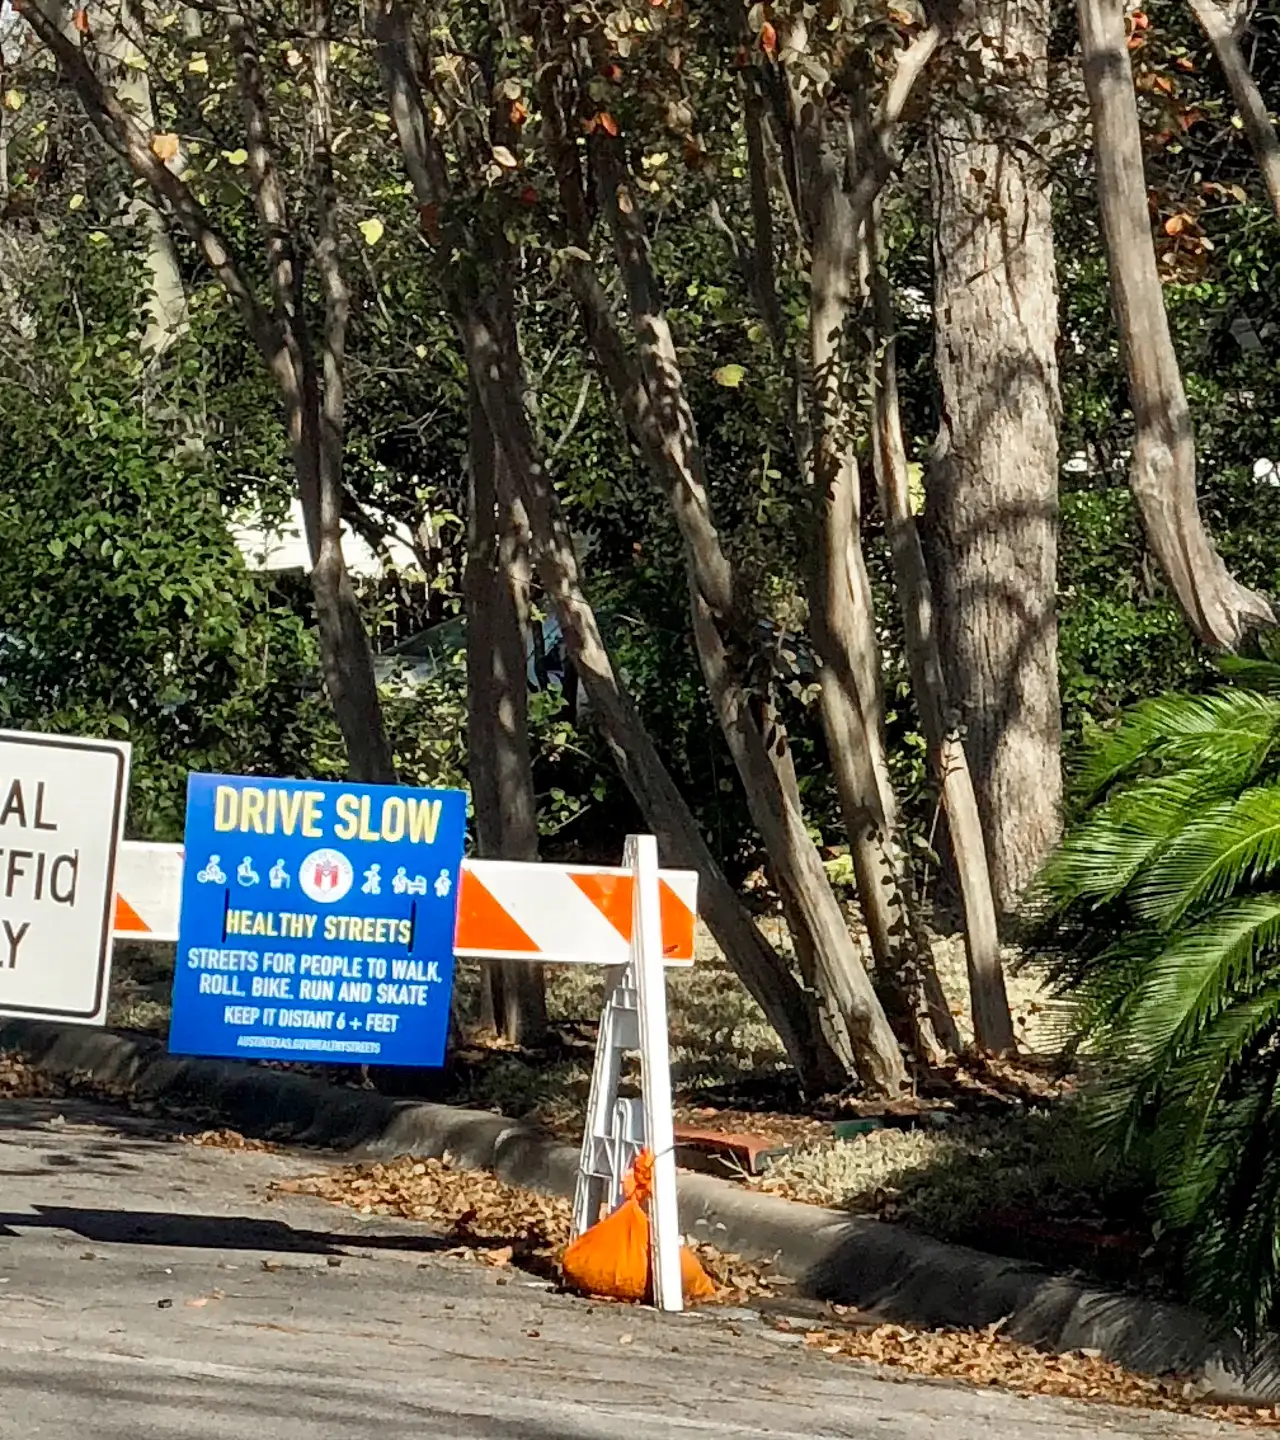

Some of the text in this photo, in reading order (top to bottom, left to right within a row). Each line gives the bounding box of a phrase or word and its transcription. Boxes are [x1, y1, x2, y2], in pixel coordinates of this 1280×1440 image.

[214, 785, 442, 844] DRIVE SLOW
[226, 909, 412, 945] HEALTHY STREETS
[188, 947, 259, 972] STREETS
[263, 952, 295, 975] FOR
[300, 954, 362, 978] PEOPLE
[367, 957, 387, 980] TO
[299, 979, 334, 1001] RUN
[338, 981, 372, 1004] AND
[376, 983, 428, 1006] SKATE
[224, 1005, 260, 1025] KEEP
[263, 1007, 277, 1026] IT
[278, 1008, 336, 1029] DISTANT
[336, 1011, 346, 1030] 6
[365, 1013, 400, 1033] FEET
